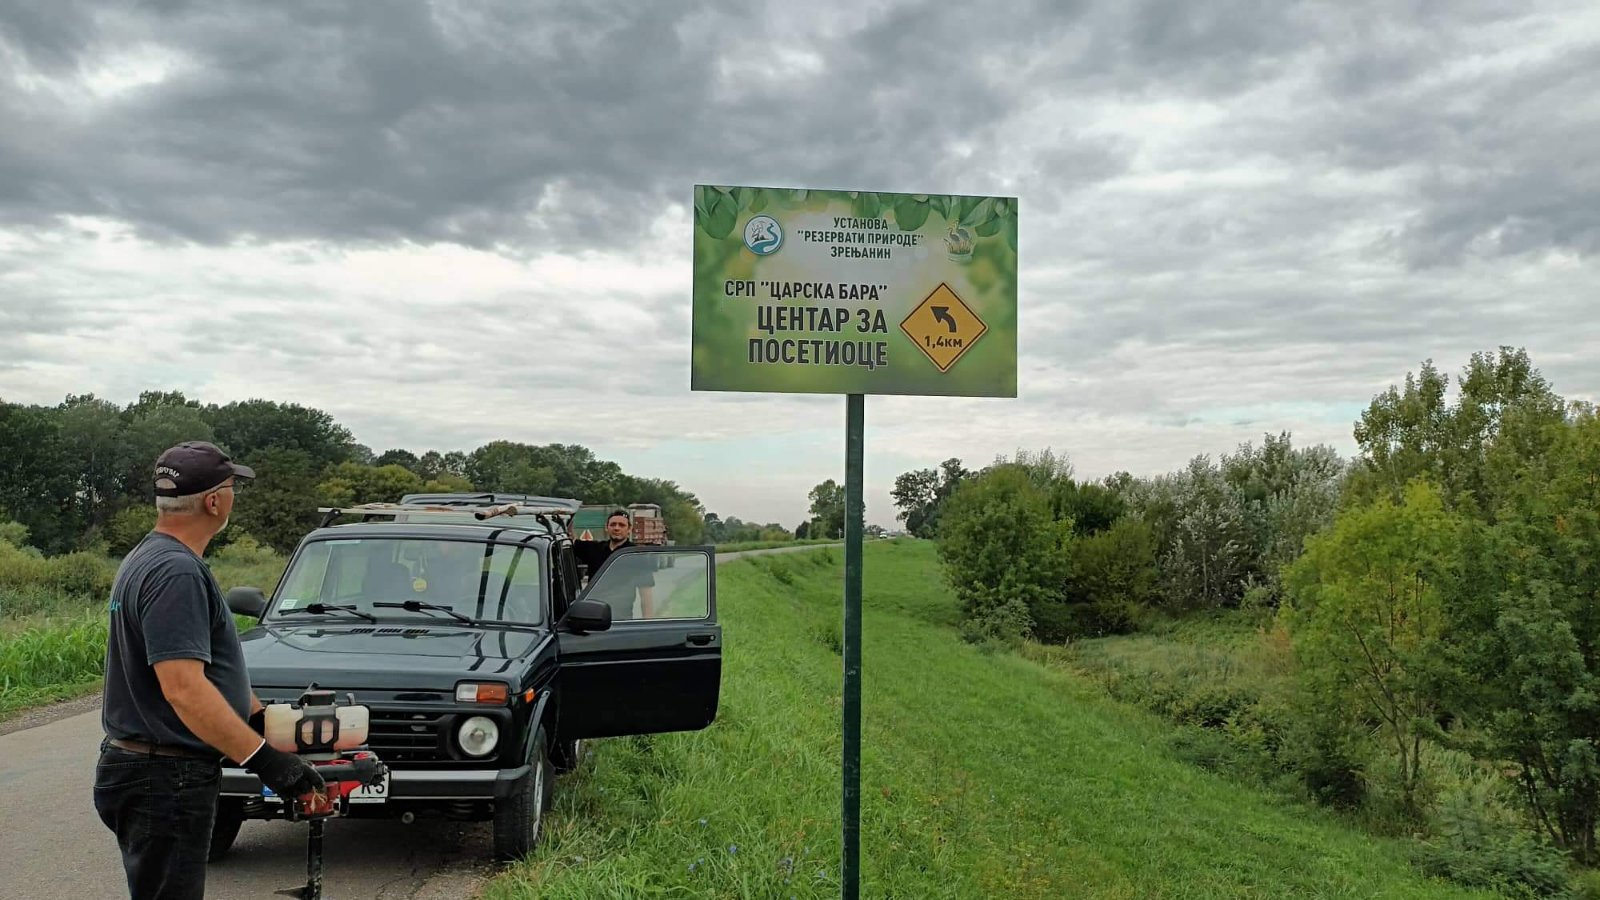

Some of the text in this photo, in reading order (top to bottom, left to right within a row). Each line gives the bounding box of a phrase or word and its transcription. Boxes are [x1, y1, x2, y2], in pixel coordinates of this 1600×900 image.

[833, 217, 889, 230] УСТАНОВА
[830, 246, 891, 259] ЗРЕЊАНИН
[725, 280, 756, 297] СРП
[758, 305, 888, 335] ЦЕНТАР ЗА
[749, 338, 888, 370] ПОСЕТИОЦЕ
